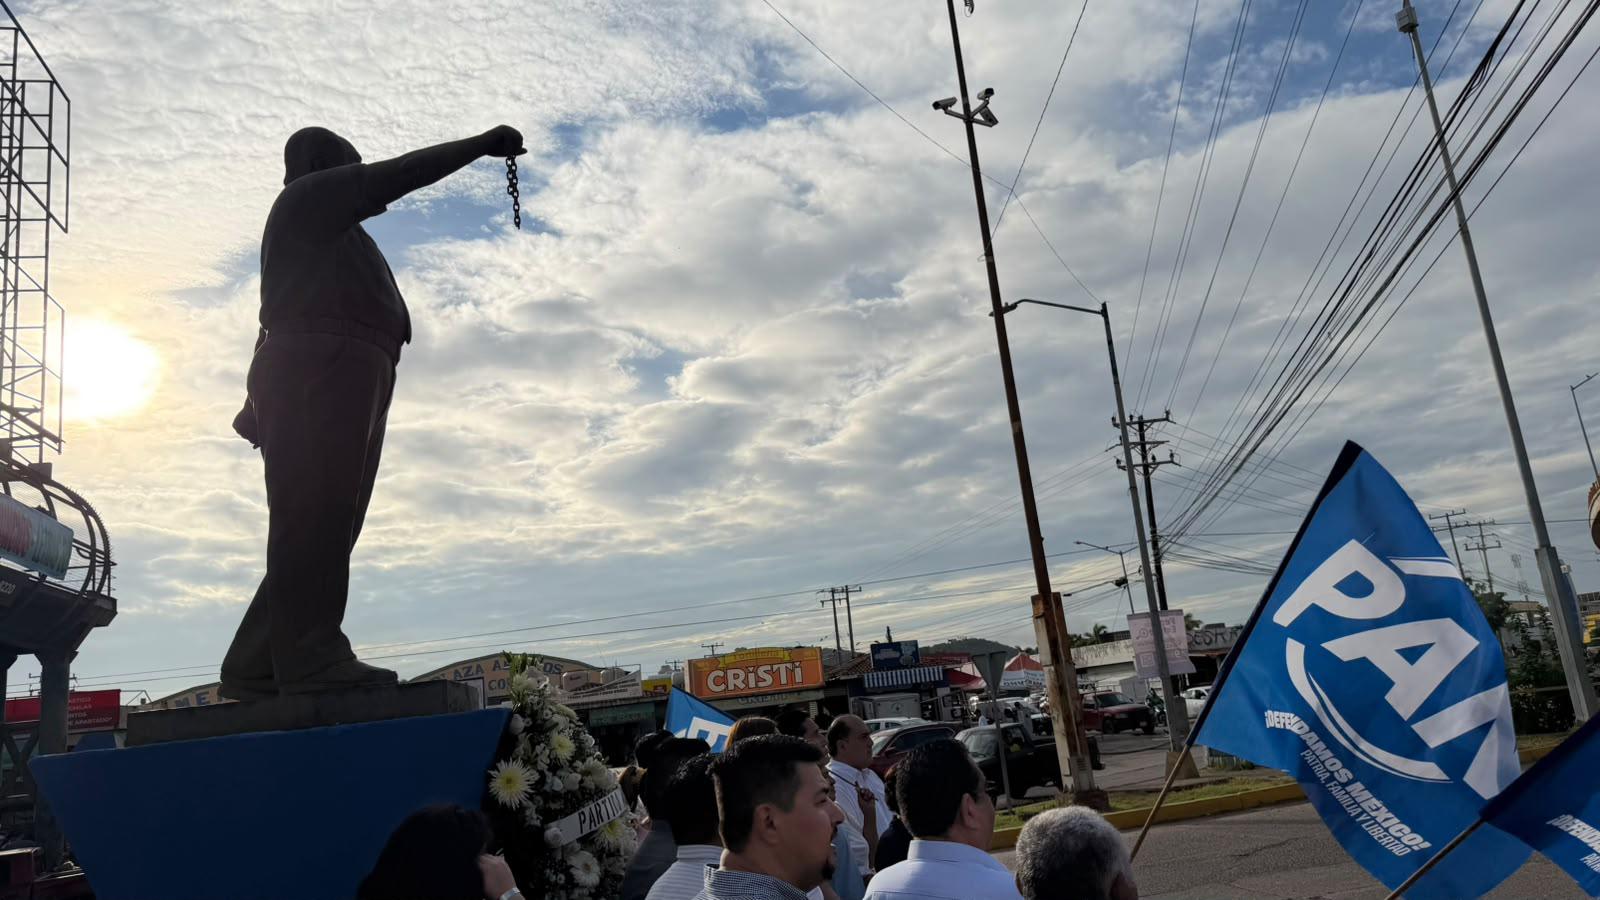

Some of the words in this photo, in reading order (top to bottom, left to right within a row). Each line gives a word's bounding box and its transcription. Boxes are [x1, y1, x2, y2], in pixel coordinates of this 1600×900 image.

[1301, 749, 1330, 784] PATRIA,
[577, 788, 626, 834] PARTID
[1327, 781, 1360, 817] FAMILIA
[1355, 810, 1368, 824] Y
[1361, 816, 1412, 857] LIBERTAD
